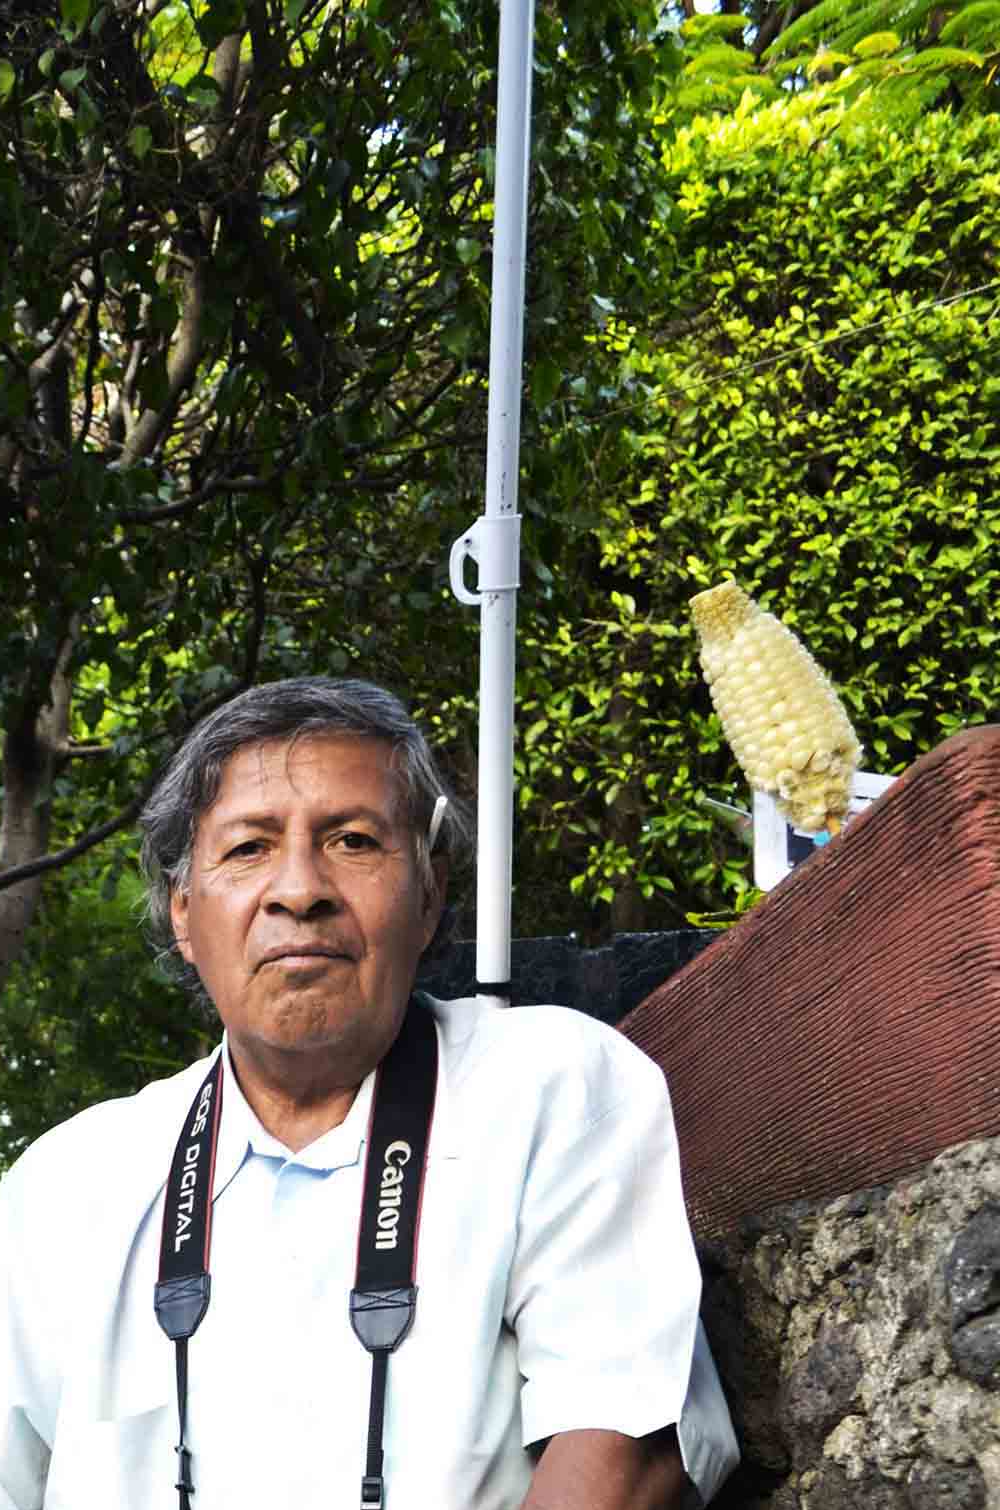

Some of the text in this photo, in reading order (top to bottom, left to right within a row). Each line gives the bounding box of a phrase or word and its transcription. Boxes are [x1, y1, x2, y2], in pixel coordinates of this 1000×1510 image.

[174, 1082, 213, 1253] EOS DIGITAL
[375, 1139, 412, 1250] Canon
